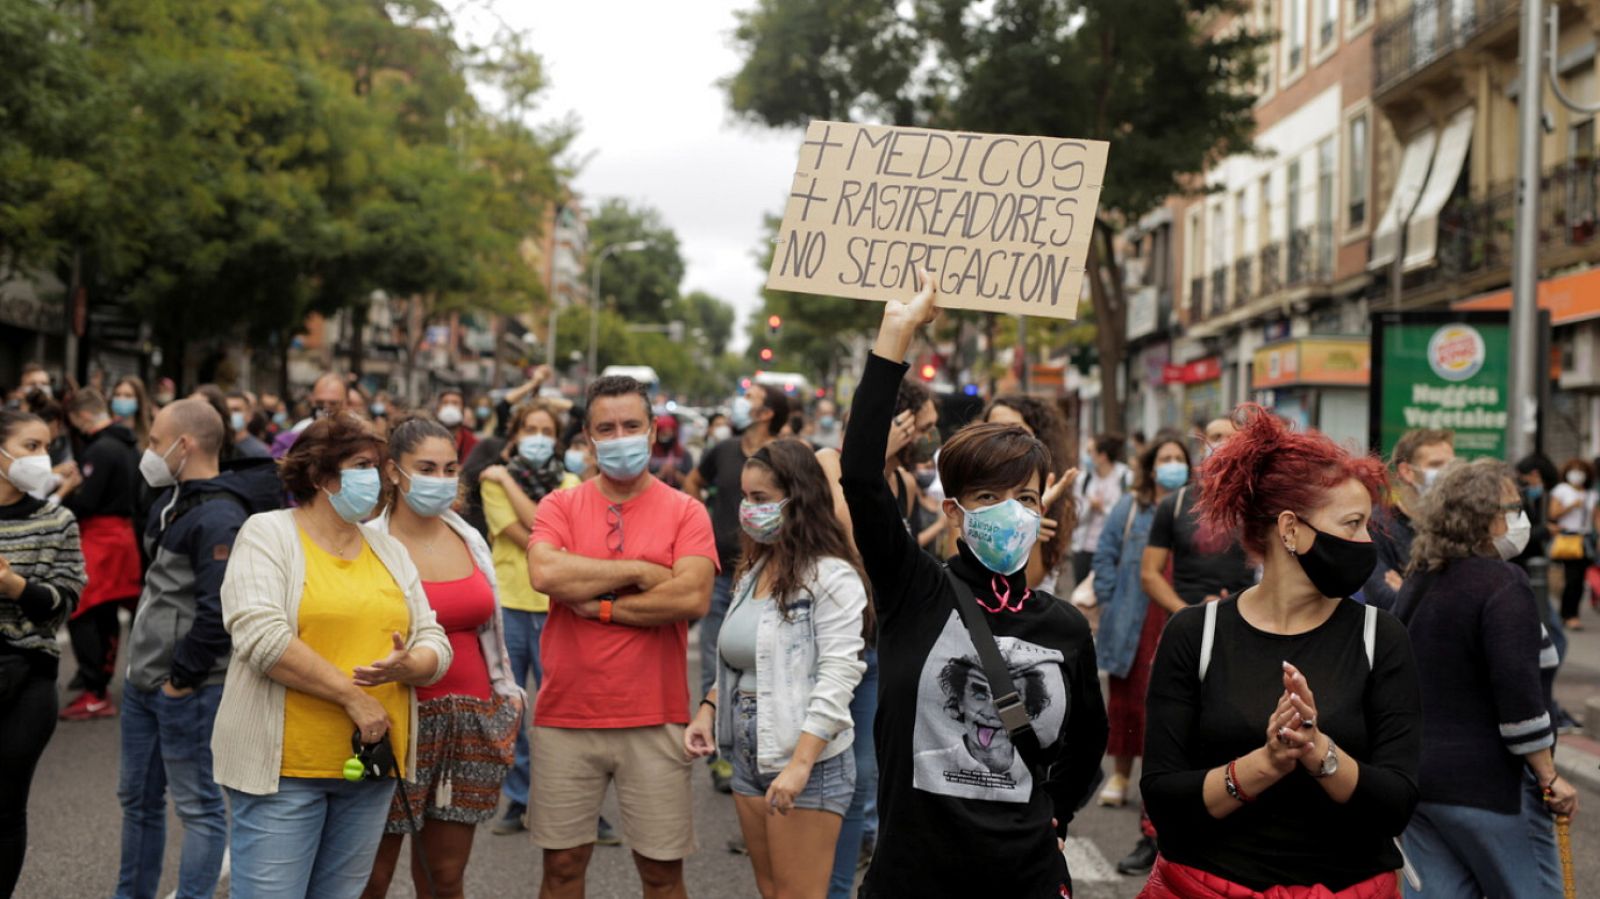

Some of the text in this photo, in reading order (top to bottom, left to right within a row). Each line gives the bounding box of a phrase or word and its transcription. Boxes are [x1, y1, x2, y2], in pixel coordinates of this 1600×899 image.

[846, 127, 1088, 191] MEDICOS
[832, 180, 1079, 247] RASTREADORES
[779, 229, 826, 279] NO
[1413, 384, 1498, 408] Nuggets
